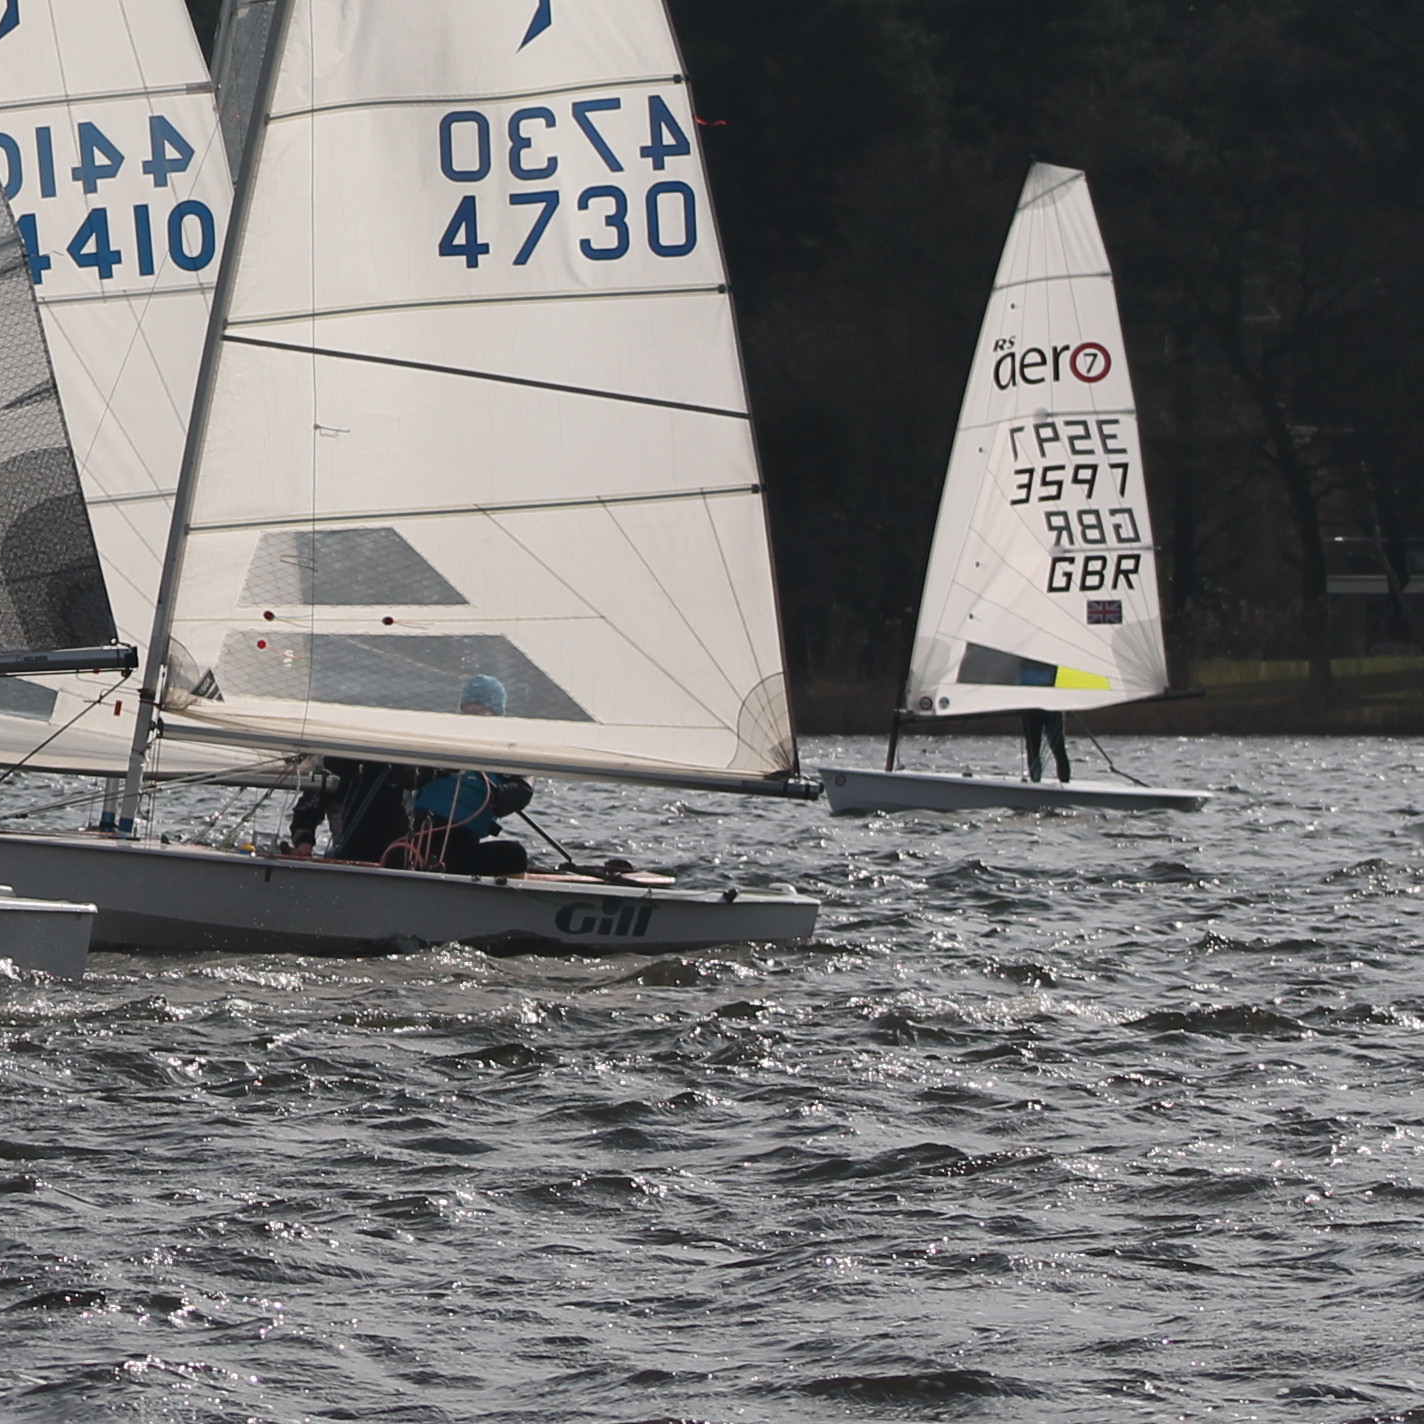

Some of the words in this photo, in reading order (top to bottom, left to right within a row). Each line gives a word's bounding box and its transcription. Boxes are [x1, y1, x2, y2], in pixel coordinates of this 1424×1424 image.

[438, 180, 698, 269] 4730
[993, 335, 1016, 352] RS
[1082, 352, 1099, 374] 7
[1010, 462, 1129, 506] 3597
[1046, 553, 1141, 593] GBR
[554, 896, 658, 937] Gill
